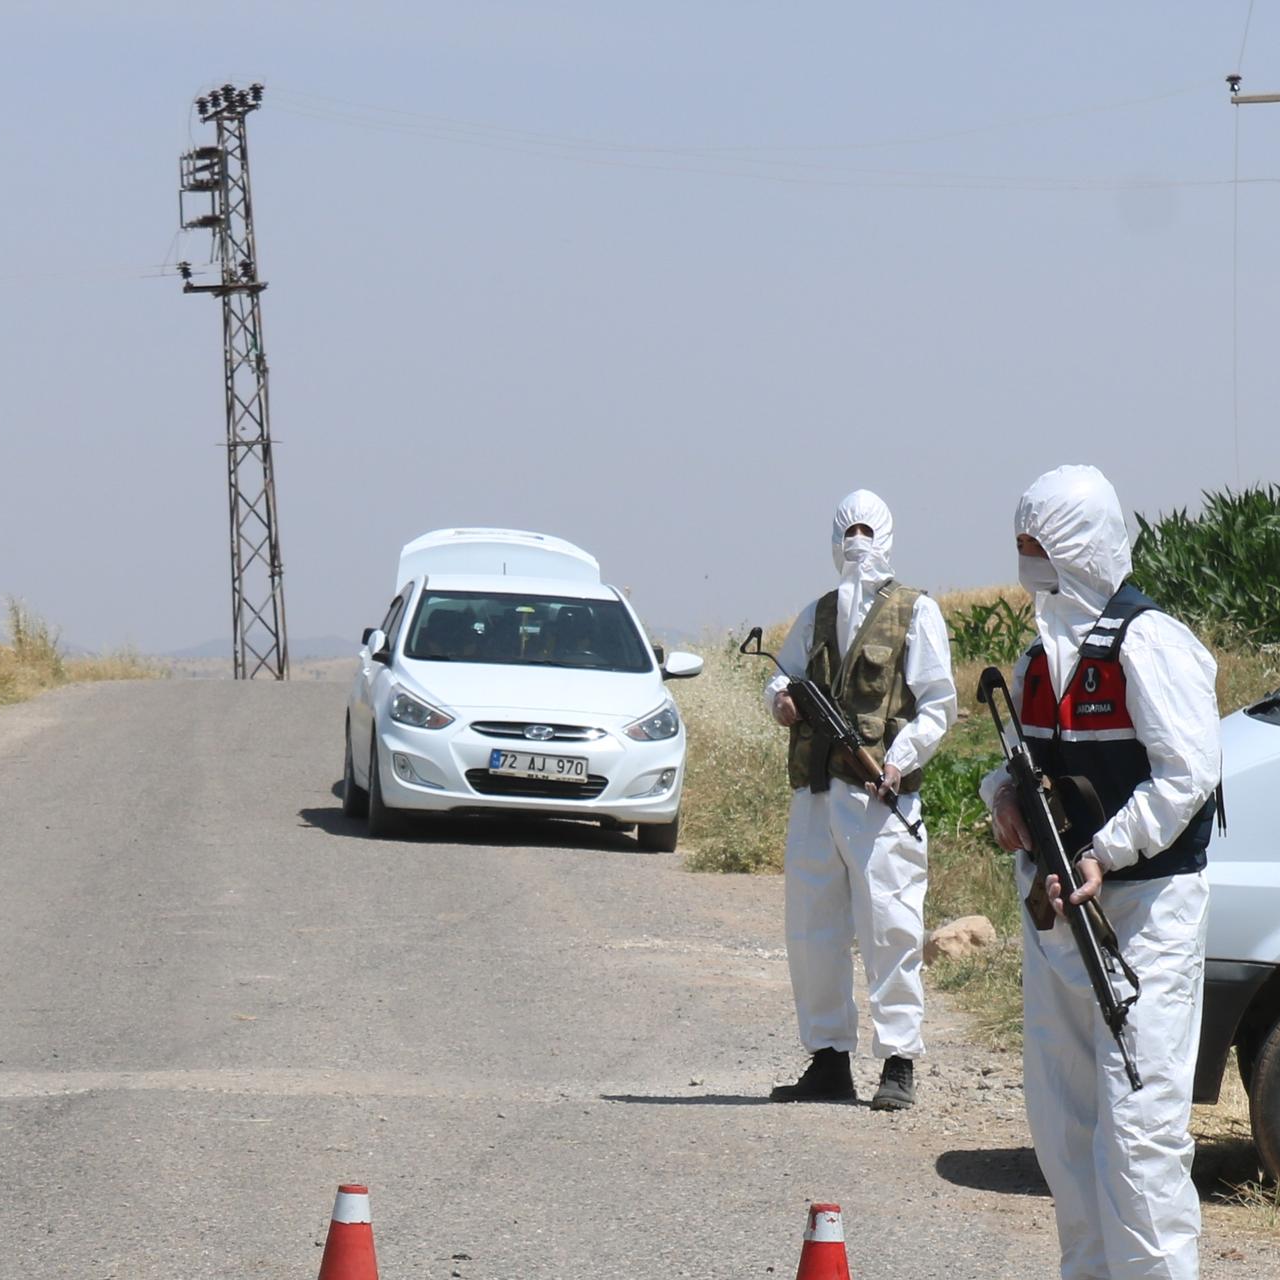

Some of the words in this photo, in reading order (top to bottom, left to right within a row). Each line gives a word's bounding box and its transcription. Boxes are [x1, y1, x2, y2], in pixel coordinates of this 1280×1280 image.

[500, 753, 518, 769] 72
[528, 756, 546, 772] AJ
[556, 759, 584, 776] 970
